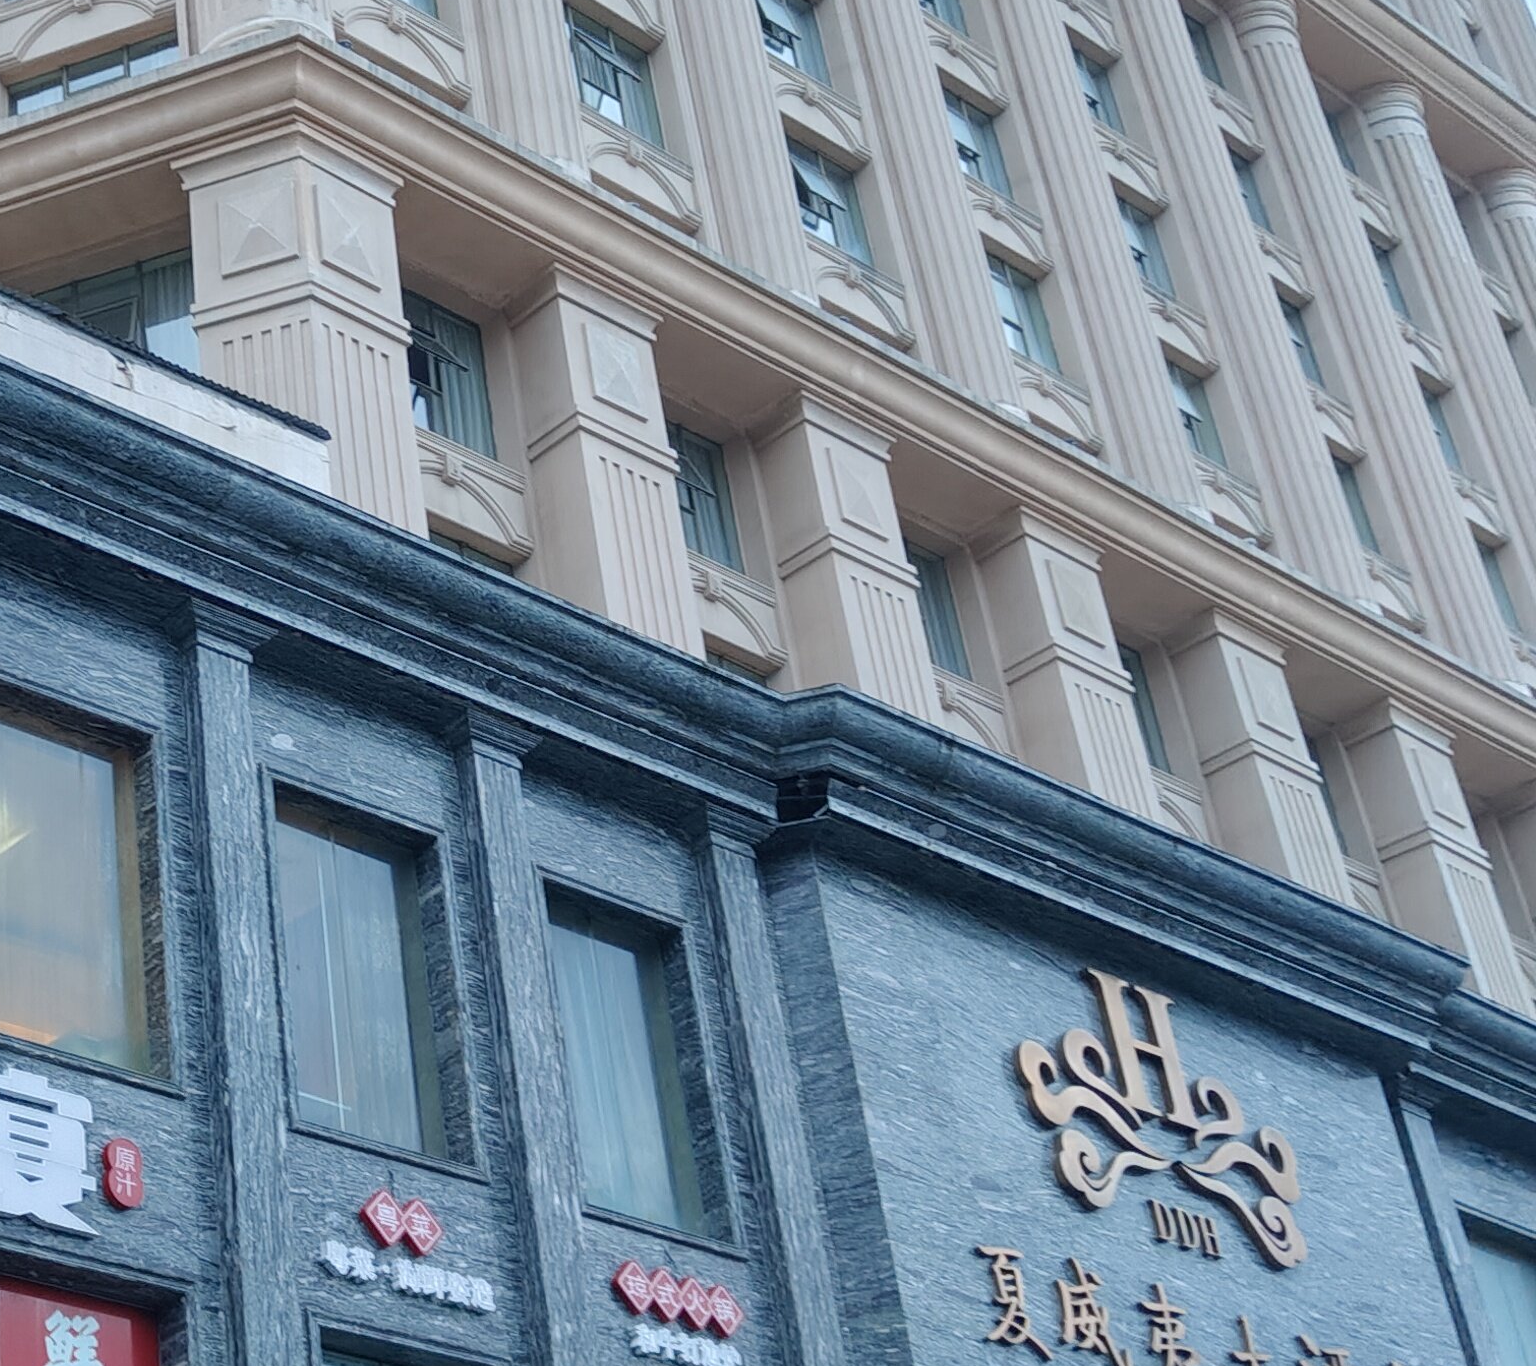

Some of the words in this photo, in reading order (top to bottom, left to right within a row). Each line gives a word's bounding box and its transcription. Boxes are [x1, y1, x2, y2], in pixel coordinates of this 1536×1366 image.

[114, 1145, 138, 1197] 原汁
[375, 1202, 434, 1241] 粤菜
[1147, 1198, 1222, 1259] DDH
